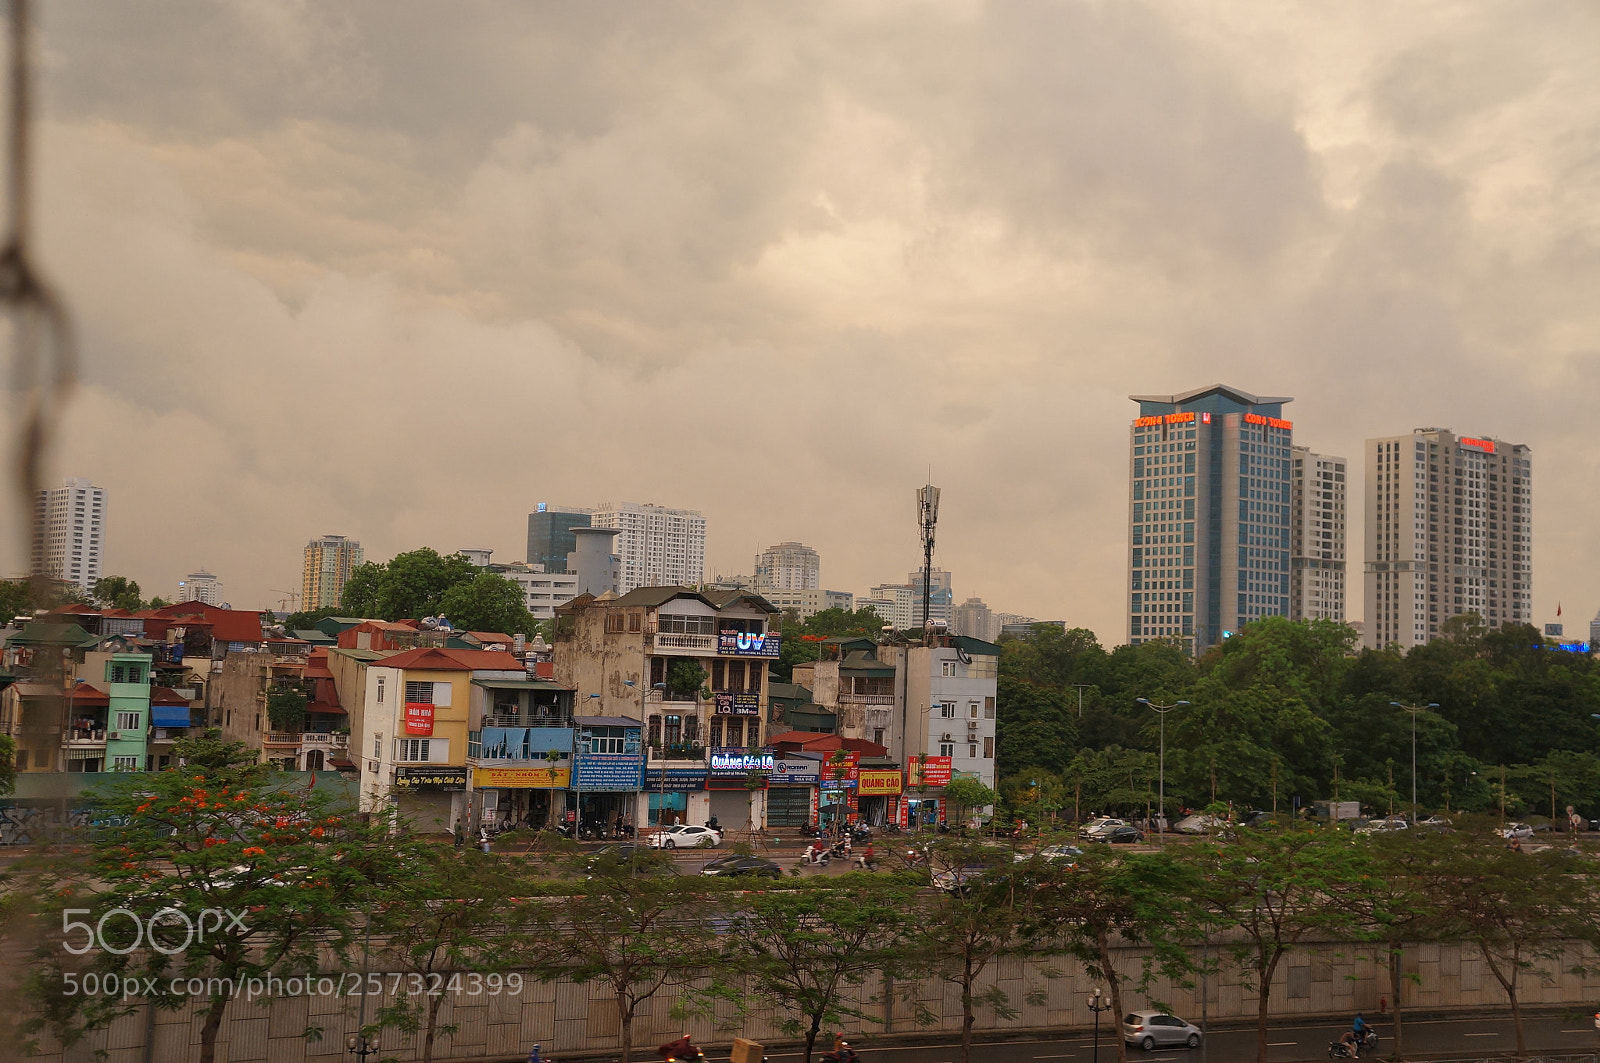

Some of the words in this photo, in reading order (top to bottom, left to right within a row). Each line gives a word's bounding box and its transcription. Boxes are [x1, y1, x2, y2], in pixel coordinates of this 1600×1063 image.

[1165, 412, 1195, 424] TOWER
[737, 632, 766, 650] UV
[886, 776, 899, 788] CÁO
